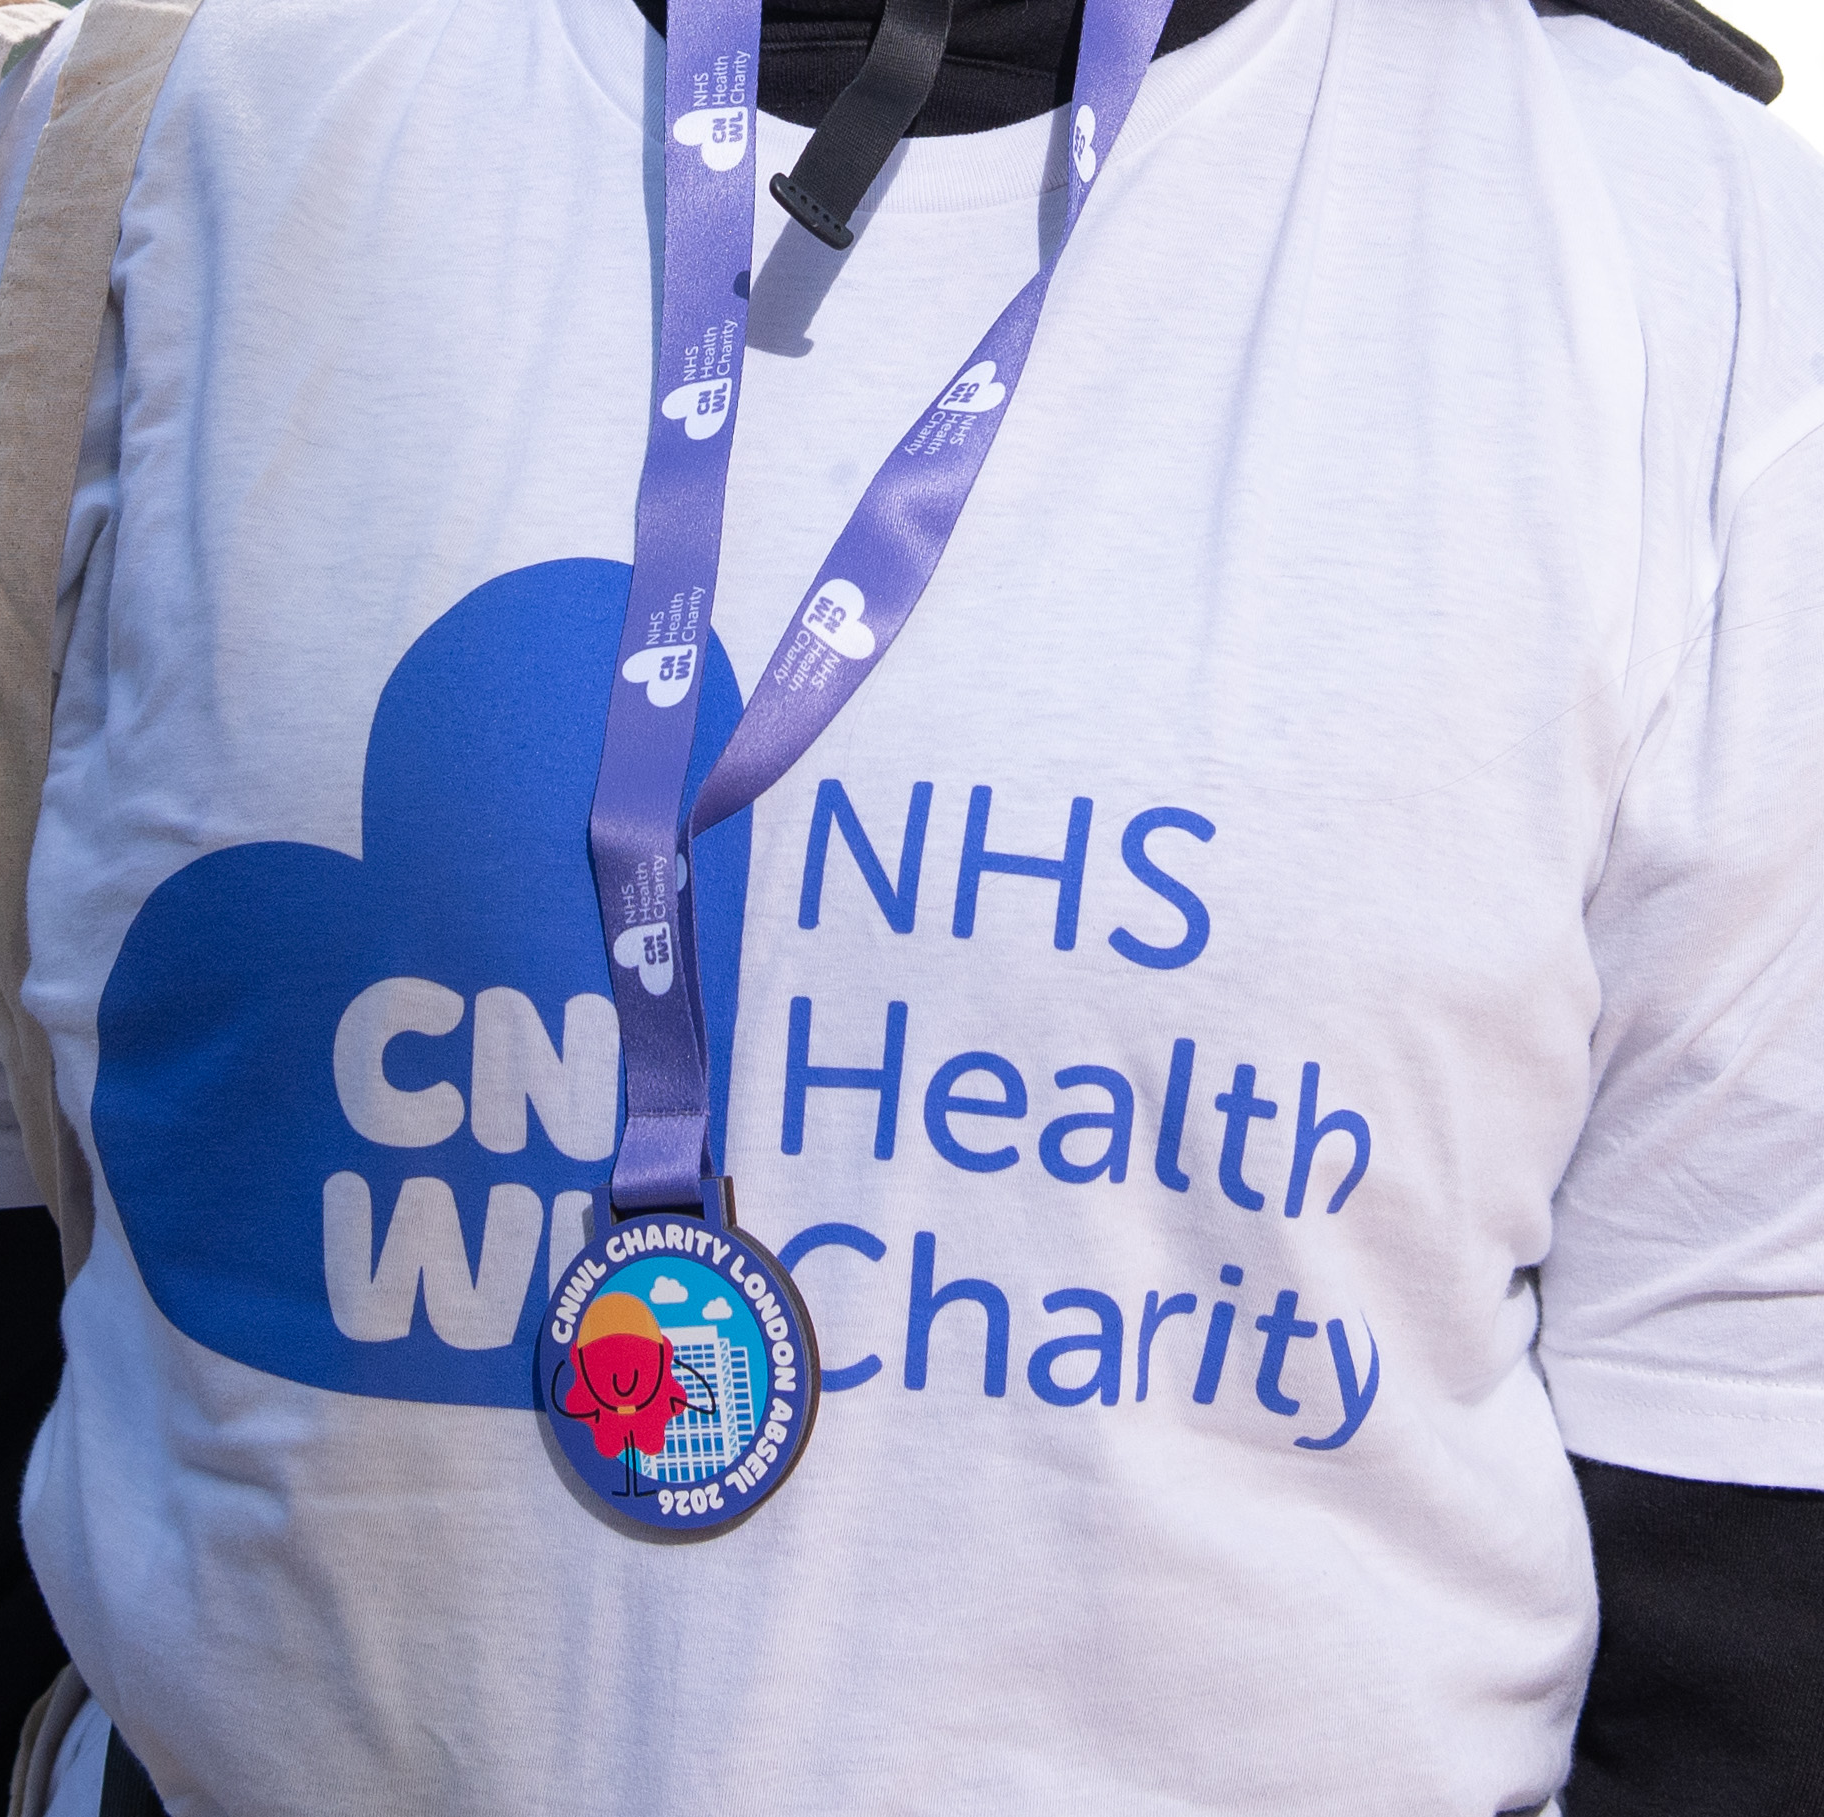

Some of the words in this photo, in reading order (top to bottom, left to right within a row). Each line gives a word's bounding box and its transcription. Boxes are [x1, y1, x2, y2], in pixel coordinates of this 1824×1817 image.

[693, 72, 709, 107] NHS
[712, 54, 730, 106] Health
[729, 50, 751, 105] Charity
[712, 117, 727, 144] CN
[728, 110, 744, 143] WL
[683, 345, 699, 382] NHS
[699, 326, 718, 379] Health
[716, 319, 738, 376] Charity
[696, 389, 712, 415] CN
[711, 382, 728, 414] WL
[943, 382, 970, 406] WL
[958, 382, 980, 403] CN
[949, 414, 978, 446] NHS
[645, 610, 665, 646] NHS
[663, 591, 685, 644] Health
[681, 585, 706, 643] Charity
[807, 595, 834, 624] WL
[823, 606, 847, 634] CN
[659, 655, 676, 681] CN
[674, 648, 693, 681] WL
[811, 651, 841, 692] NHS
[797, 778, 1217, 970] NHS
[621, 884, 637, 924] NHS
[643, 935, 657, 966] CN
[656, 927, 670, 964] WL
[332, 976, 621, 1163] CN
[780, 996, 1372, 1219] Health
[605, 1223, 731, 1265] CHARITY
[550, 1258, 607, 1345] CNWL
[729, 1254, 797, 1392] LONDON
[775, 1222, 1381, 1451] Charity
[725, 1398, 794, 1494] ABSEIL
[657, 1482, 725, 1516] 2026
